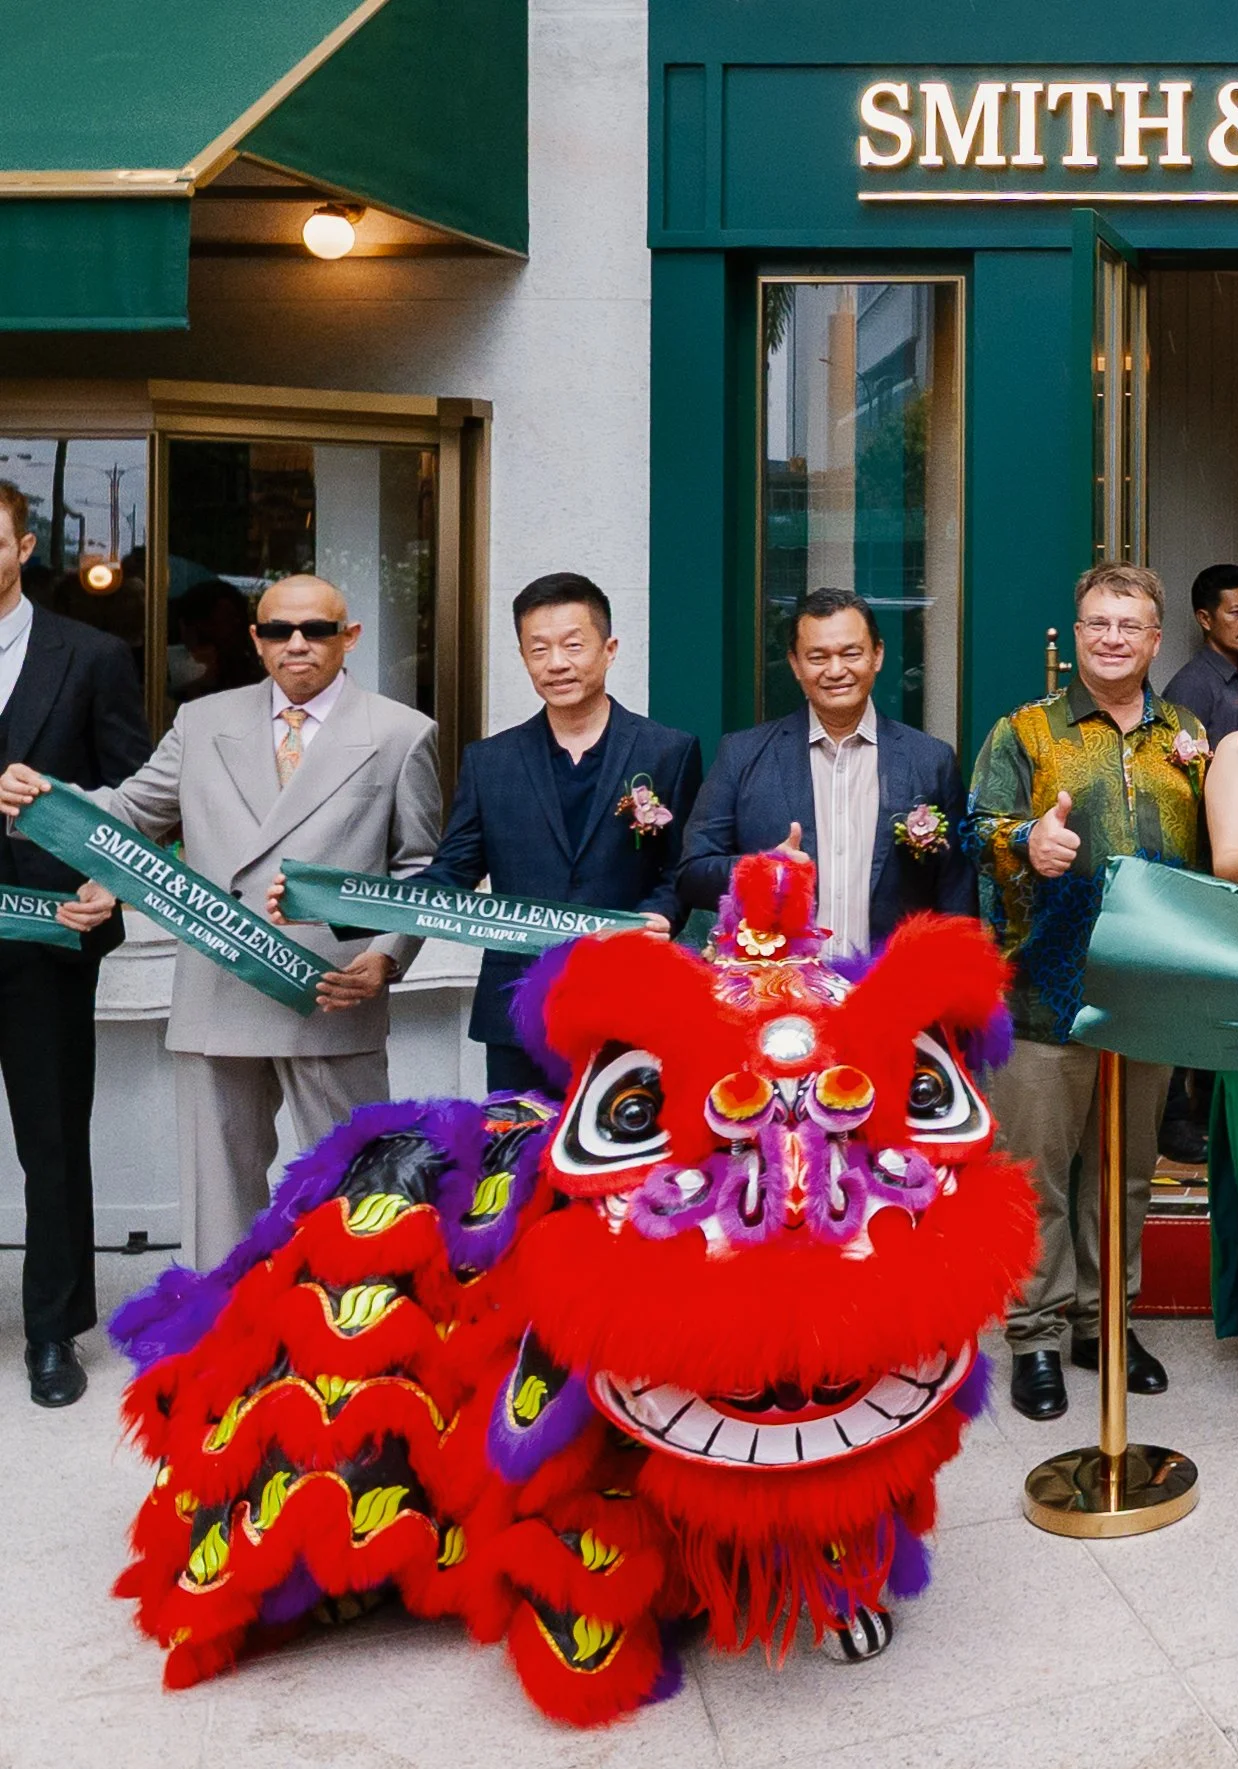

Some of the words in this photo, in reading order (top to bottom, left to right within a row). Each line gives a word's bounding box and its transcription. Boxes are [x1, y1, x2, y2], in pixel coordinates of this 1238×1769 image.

[858, 80, 1194, 168] SMITH
[0, 893, 62, 917] NSK
[89, 823, 172, 893] SMITH
[188, 882, 321, 985] WOLLENSKY
[143, 891, 185, 926] KUALA
[186, 920, 241, 963] LUMPUR
[340, 877, 429, 906] SMITH
[454, 892, 611, 933] WOLLENSKY
[415, 913, 463, 934] KUALA
[467, 924, 529, 943] LUMPUR
